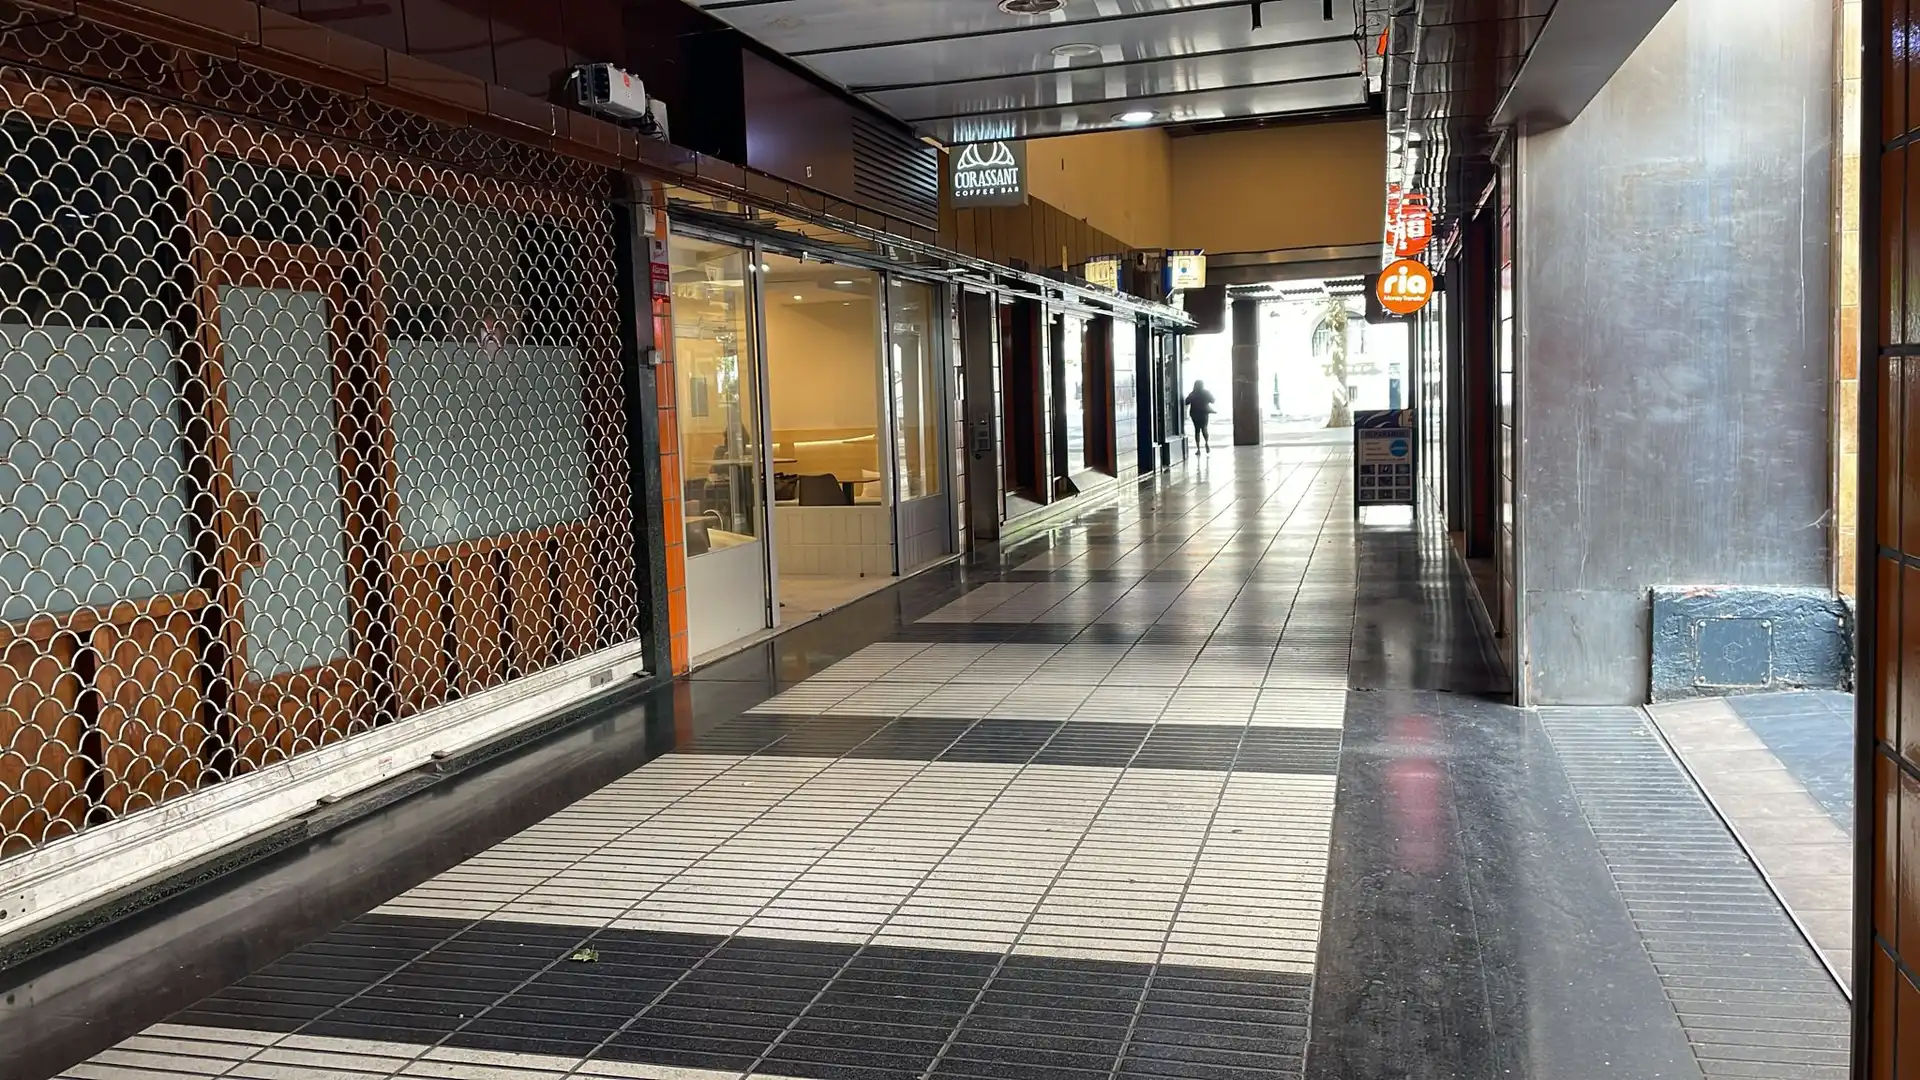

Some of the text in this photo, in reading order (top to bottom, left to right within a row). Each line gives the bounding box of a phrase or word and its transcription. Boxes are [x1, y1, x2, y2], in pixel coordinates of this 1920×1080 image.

[954, 167, 1019, 189] CORASSANT
[955, 186, 1019, 197] COFFEE BAR
[1384, 266, 1427, 294] ria
